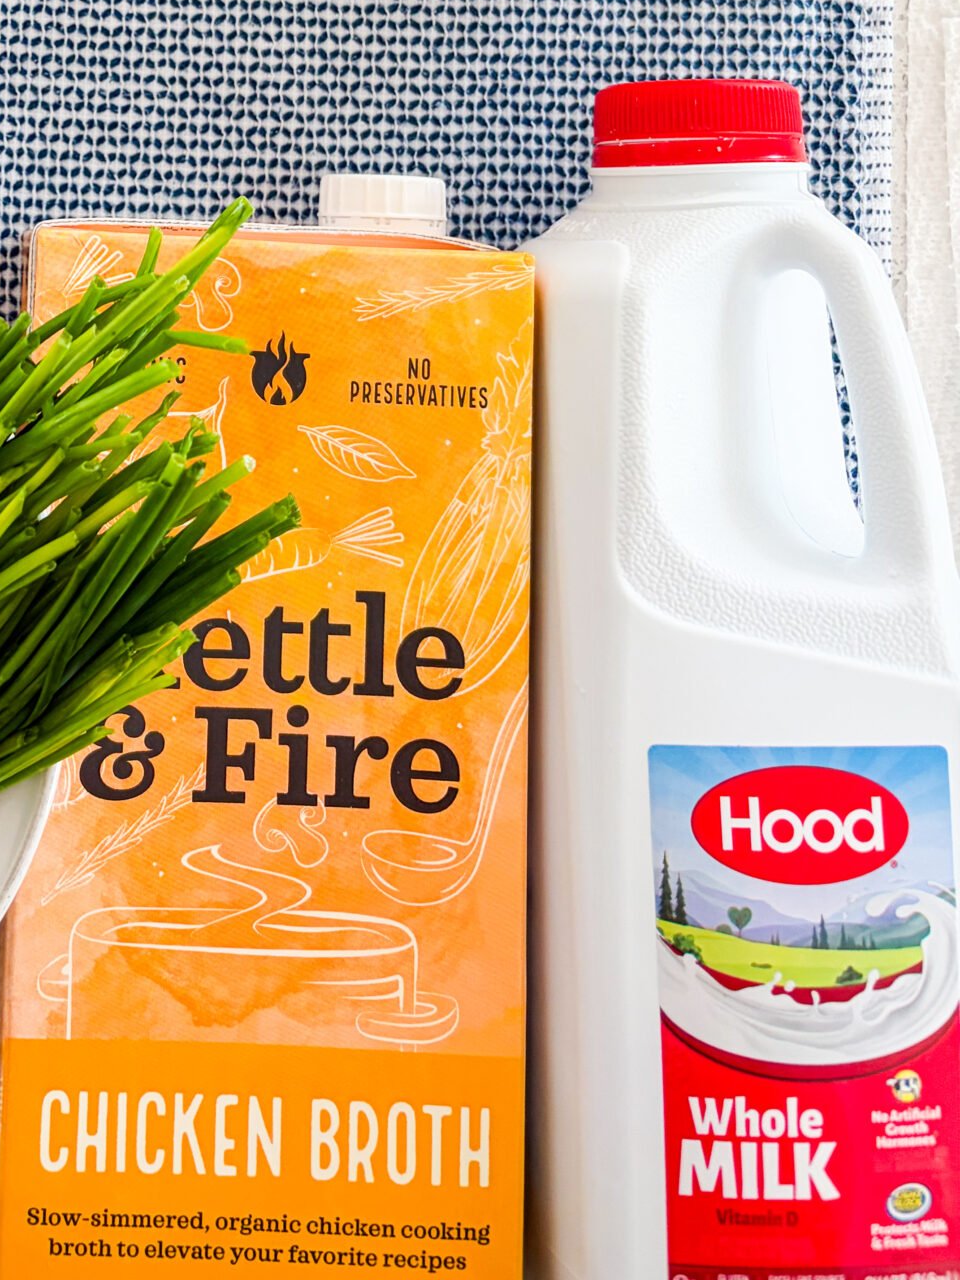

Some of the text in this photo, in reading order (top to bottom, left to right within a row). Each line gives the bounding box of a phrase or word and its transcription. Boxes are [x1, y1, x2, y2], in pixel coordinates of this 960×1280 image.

[407, 357, 431, 380] NO
[350, 381, 488, 409] PRESERVATIVES
[151, 590, 466, 701] ettle
[79, 704, 461, 814] & Fire
[719, 796, 885, 853] Hood
[39, 1089, 492, 1189] CHICKEN BROTH
[688, 1096, 824, 1139] Whole
[678, 1139, 841, 1201] MILK
[26, 1207, 491, 1246] Slow-simmered, organic chicken cooking
[715, 1208, 799, 1227] Vitamin D
[48, 1237, 467, 1273] broth to elevate your favorite recipes
